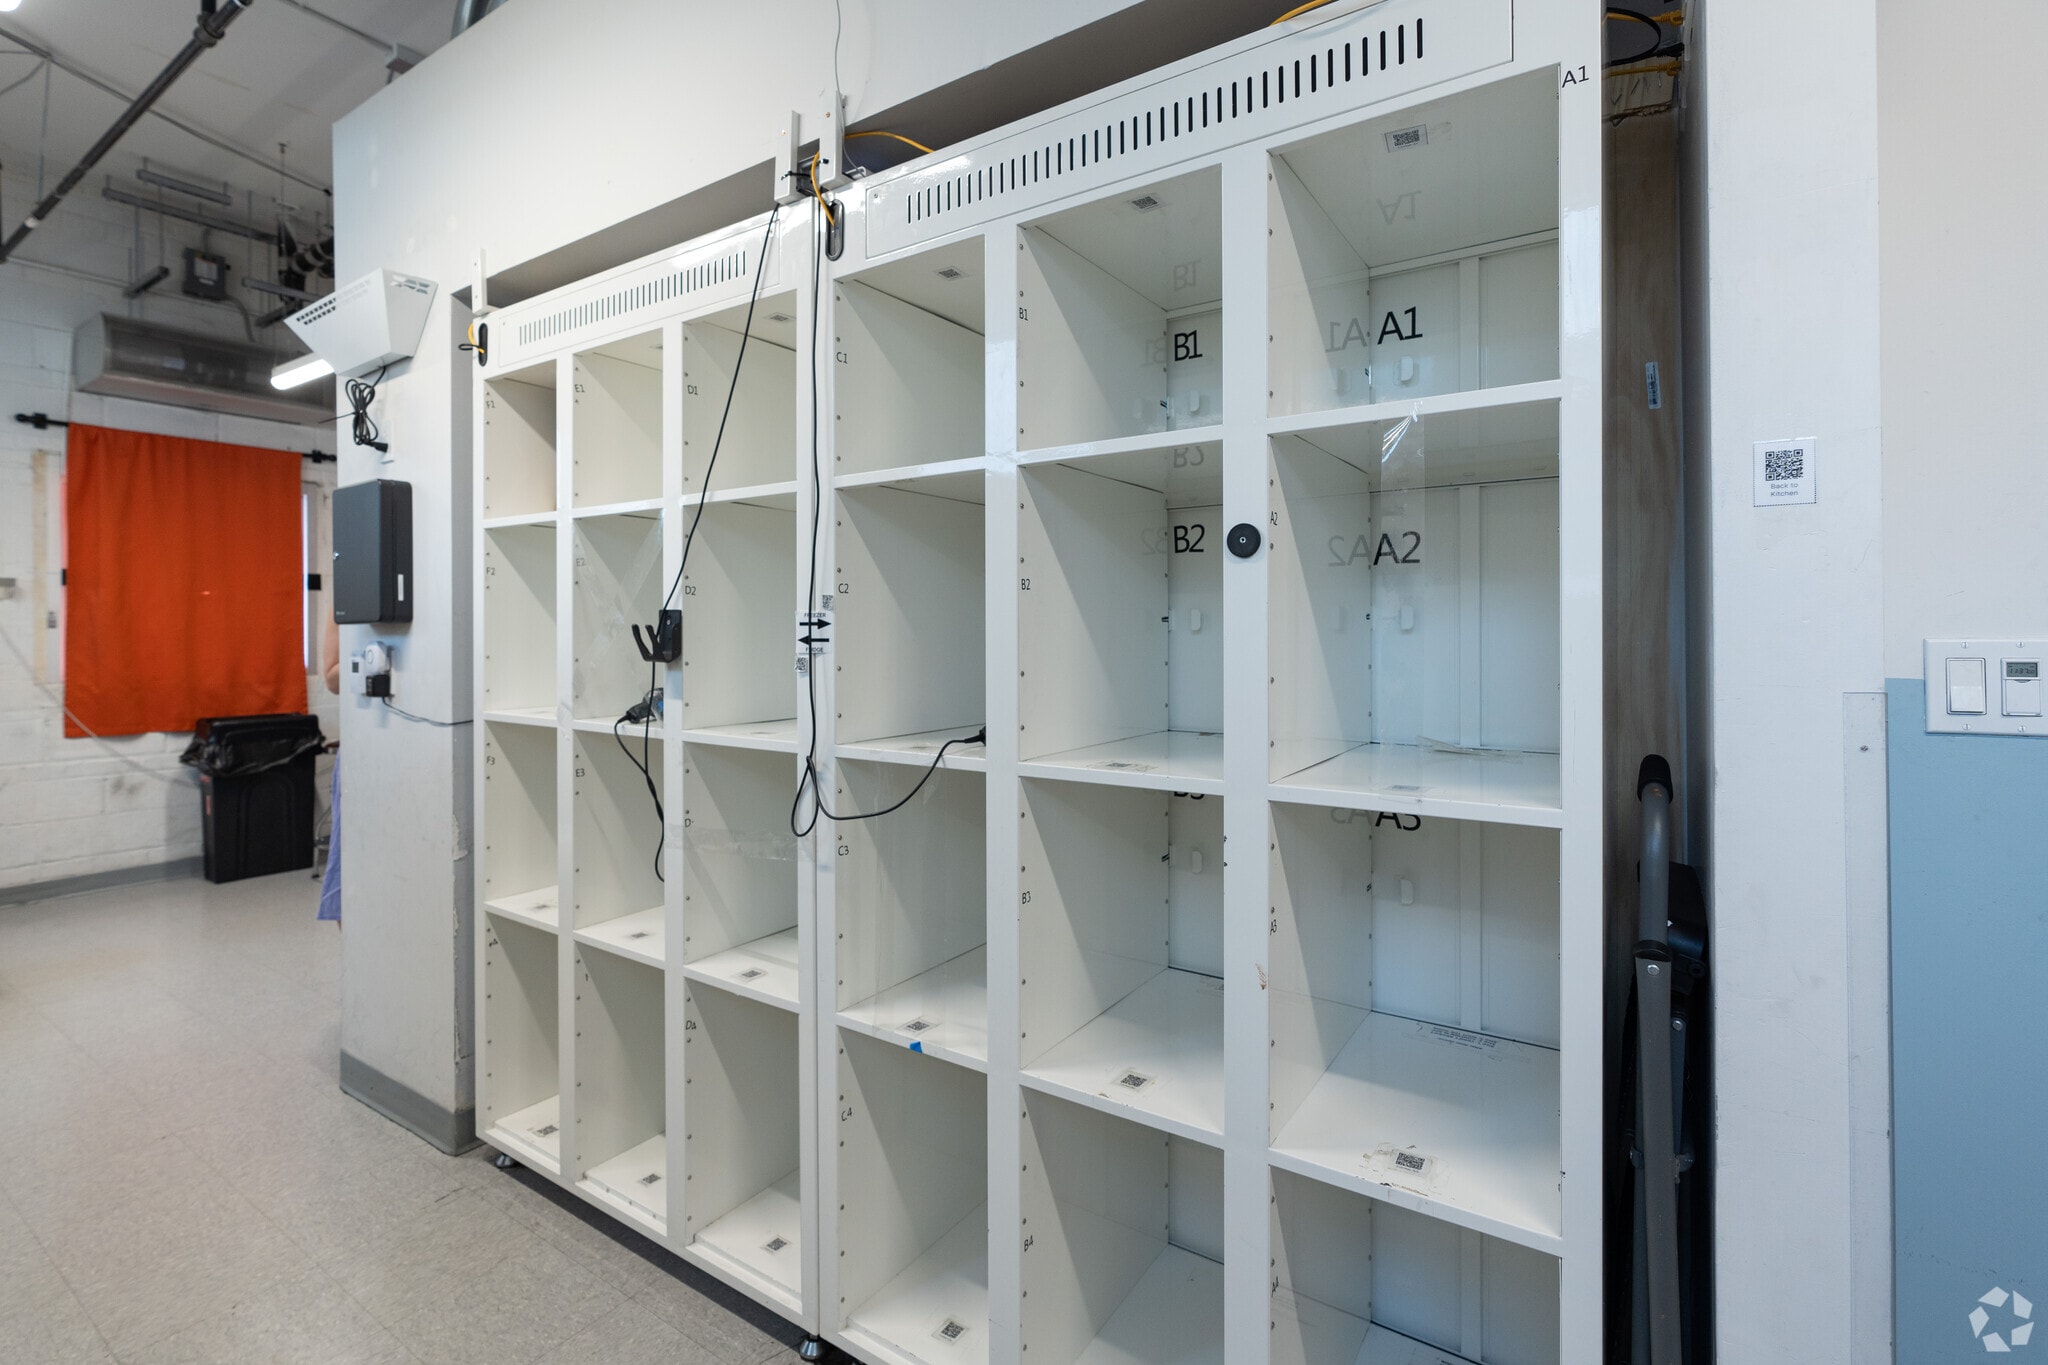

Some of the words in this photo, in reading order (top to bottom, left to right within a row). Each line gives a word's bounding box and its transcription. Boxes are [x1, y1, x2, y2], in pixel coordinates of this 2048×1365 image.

[1562, 65, 1590, 89] A1
[1018, 307, 1029, 322] B1
[1377, 306, 1423, 345] A1
[1174, 329, 1204, 362] B1
[836, 351, 848, 364] C1
[574, 384, 585, 394] E1
[687, 384, 699, 396] D1
[1269, 510, 1278, 526] A2
[1174, 524, 1205, 553] B2
[1373, 531, 1421, 566] A2
[684, 585, 697, 596] D2
[837, 583, 850, 594] C2
[1021, 578, 1031, 591] B2
[575, 768, 586, 778] E3
[837, 845, 850, 857] C3
[1021, 890, 1032, 905] B3
[841, 1106, 853, 1122] C4
[1023, 1235, 1034, 1252] B4
